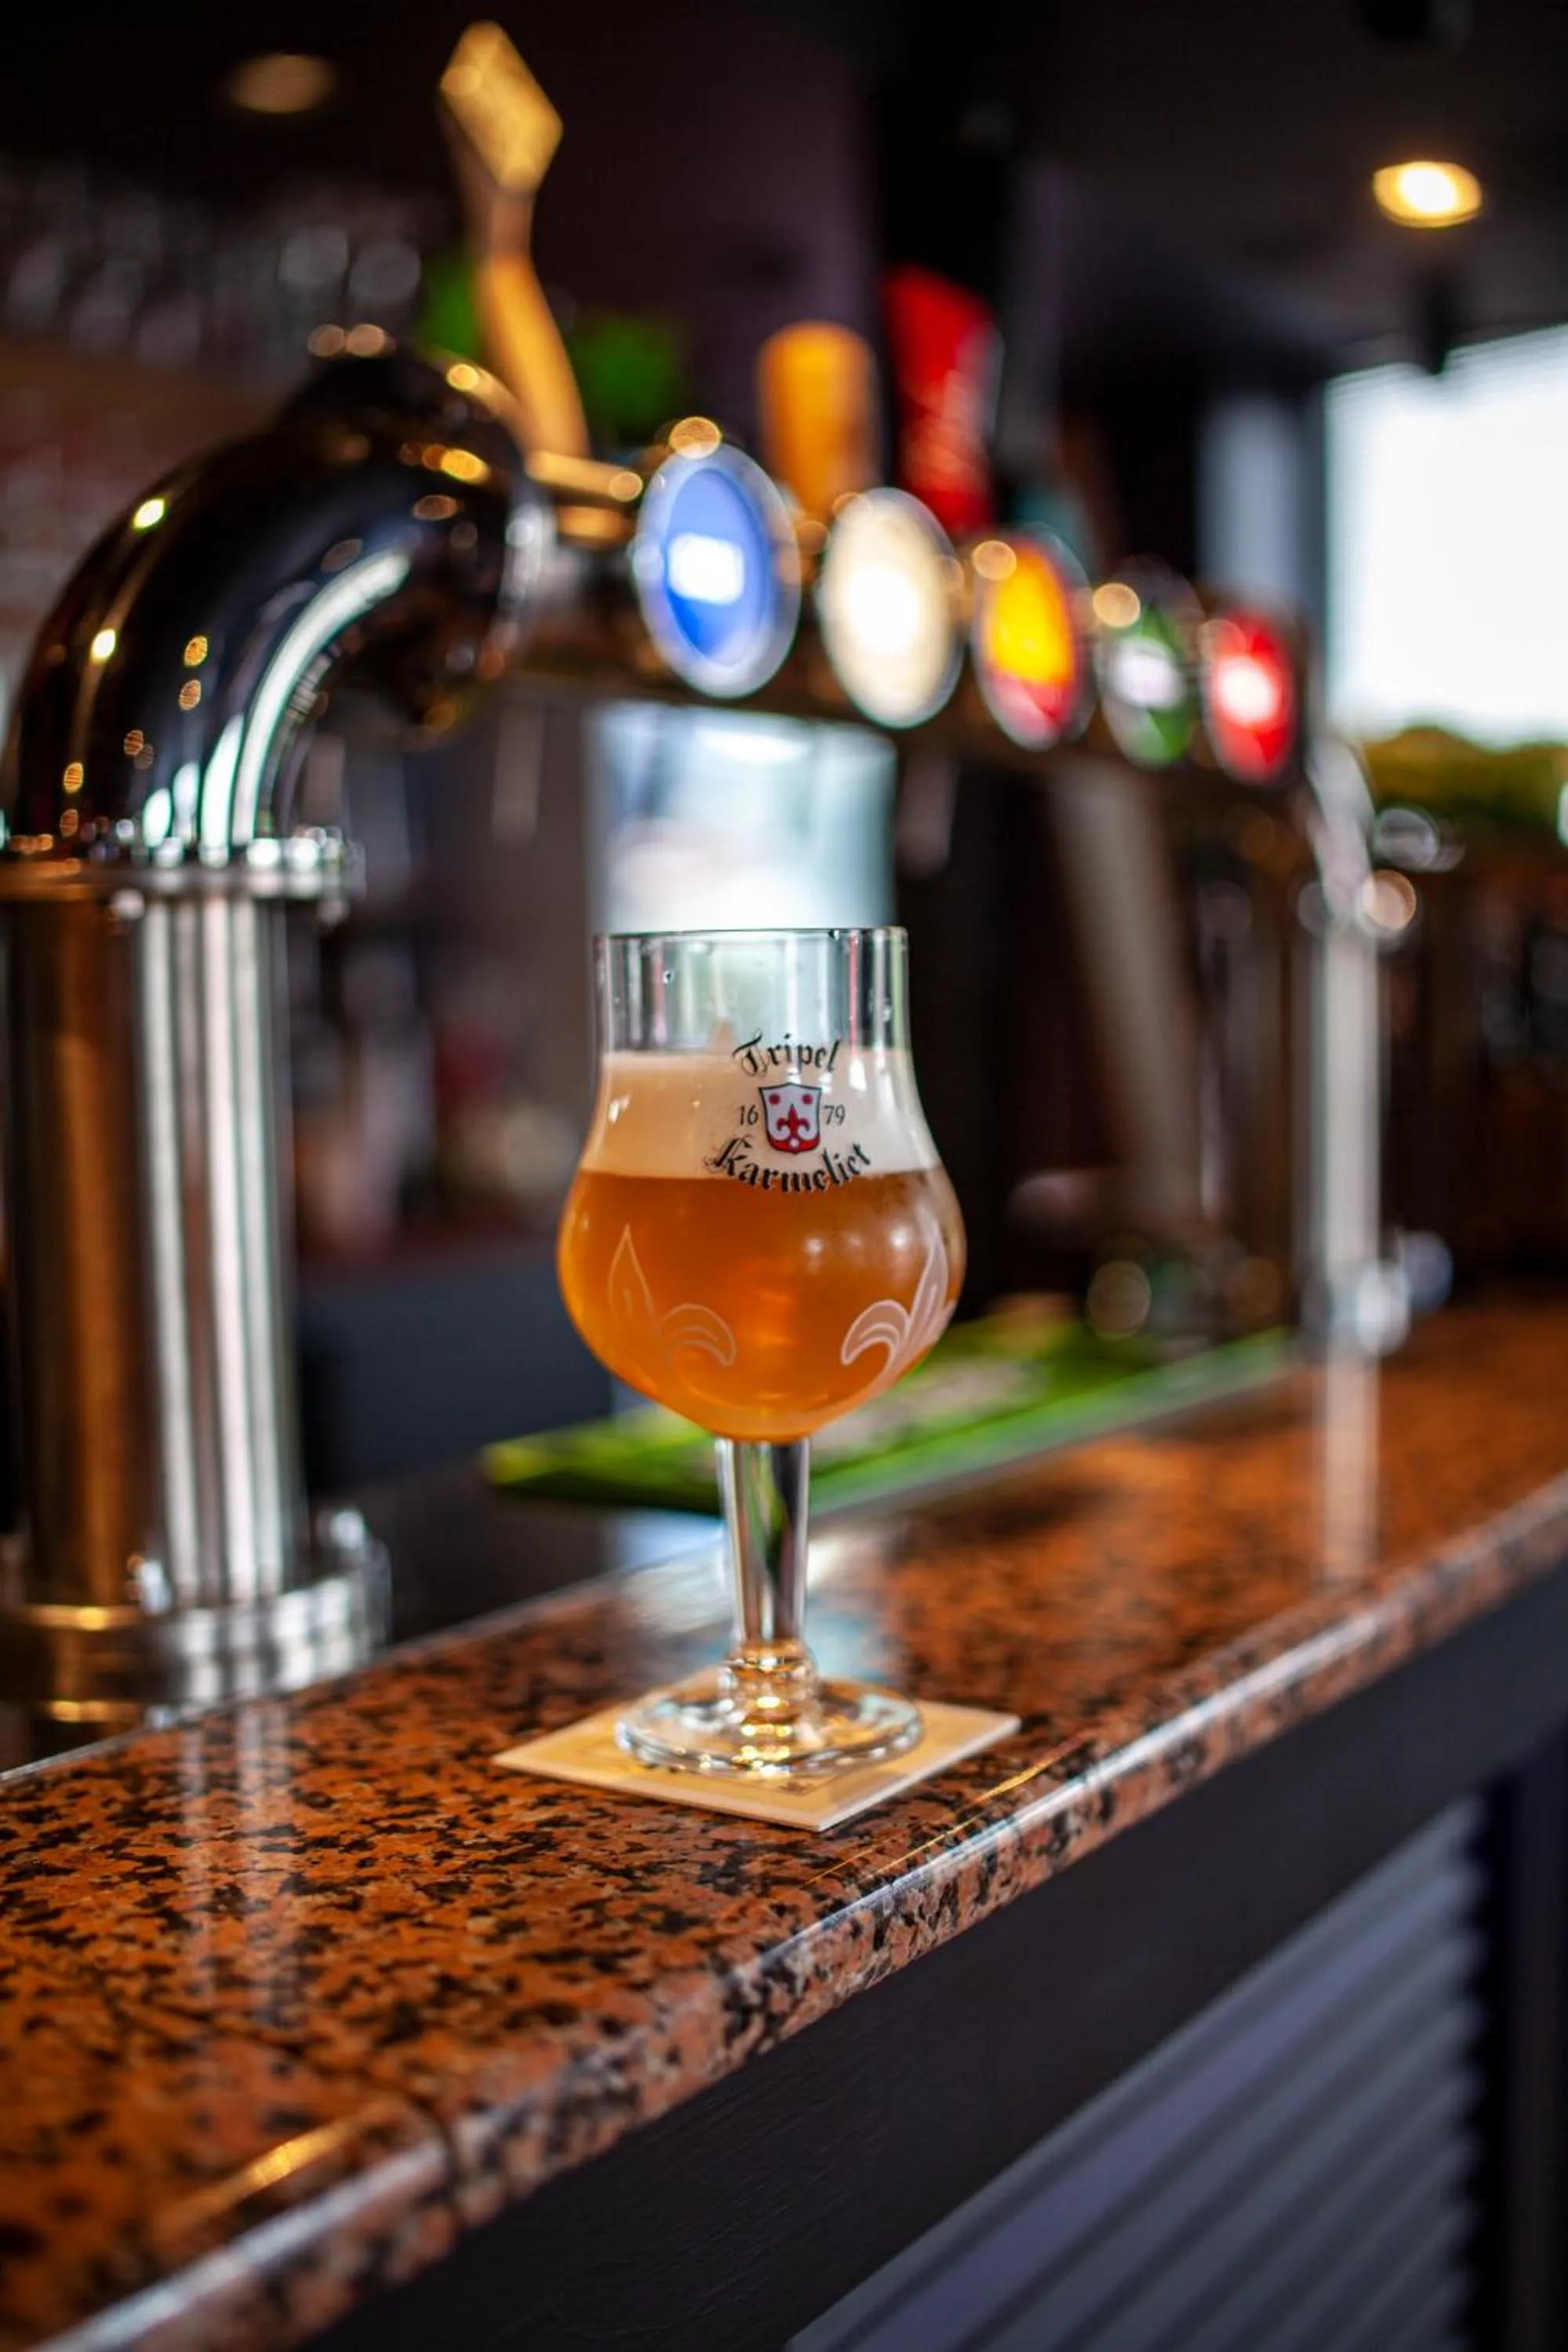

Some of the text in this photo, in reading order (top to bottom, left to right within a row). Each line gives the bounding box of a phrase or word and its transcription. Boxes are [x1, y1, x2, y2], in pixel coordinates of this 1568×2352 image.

[732, 1029, 841, 1076] Tripel
[739, 1104, 846, 1126] 16 79
[704, 1135, 871, 1192] Karmeliet
